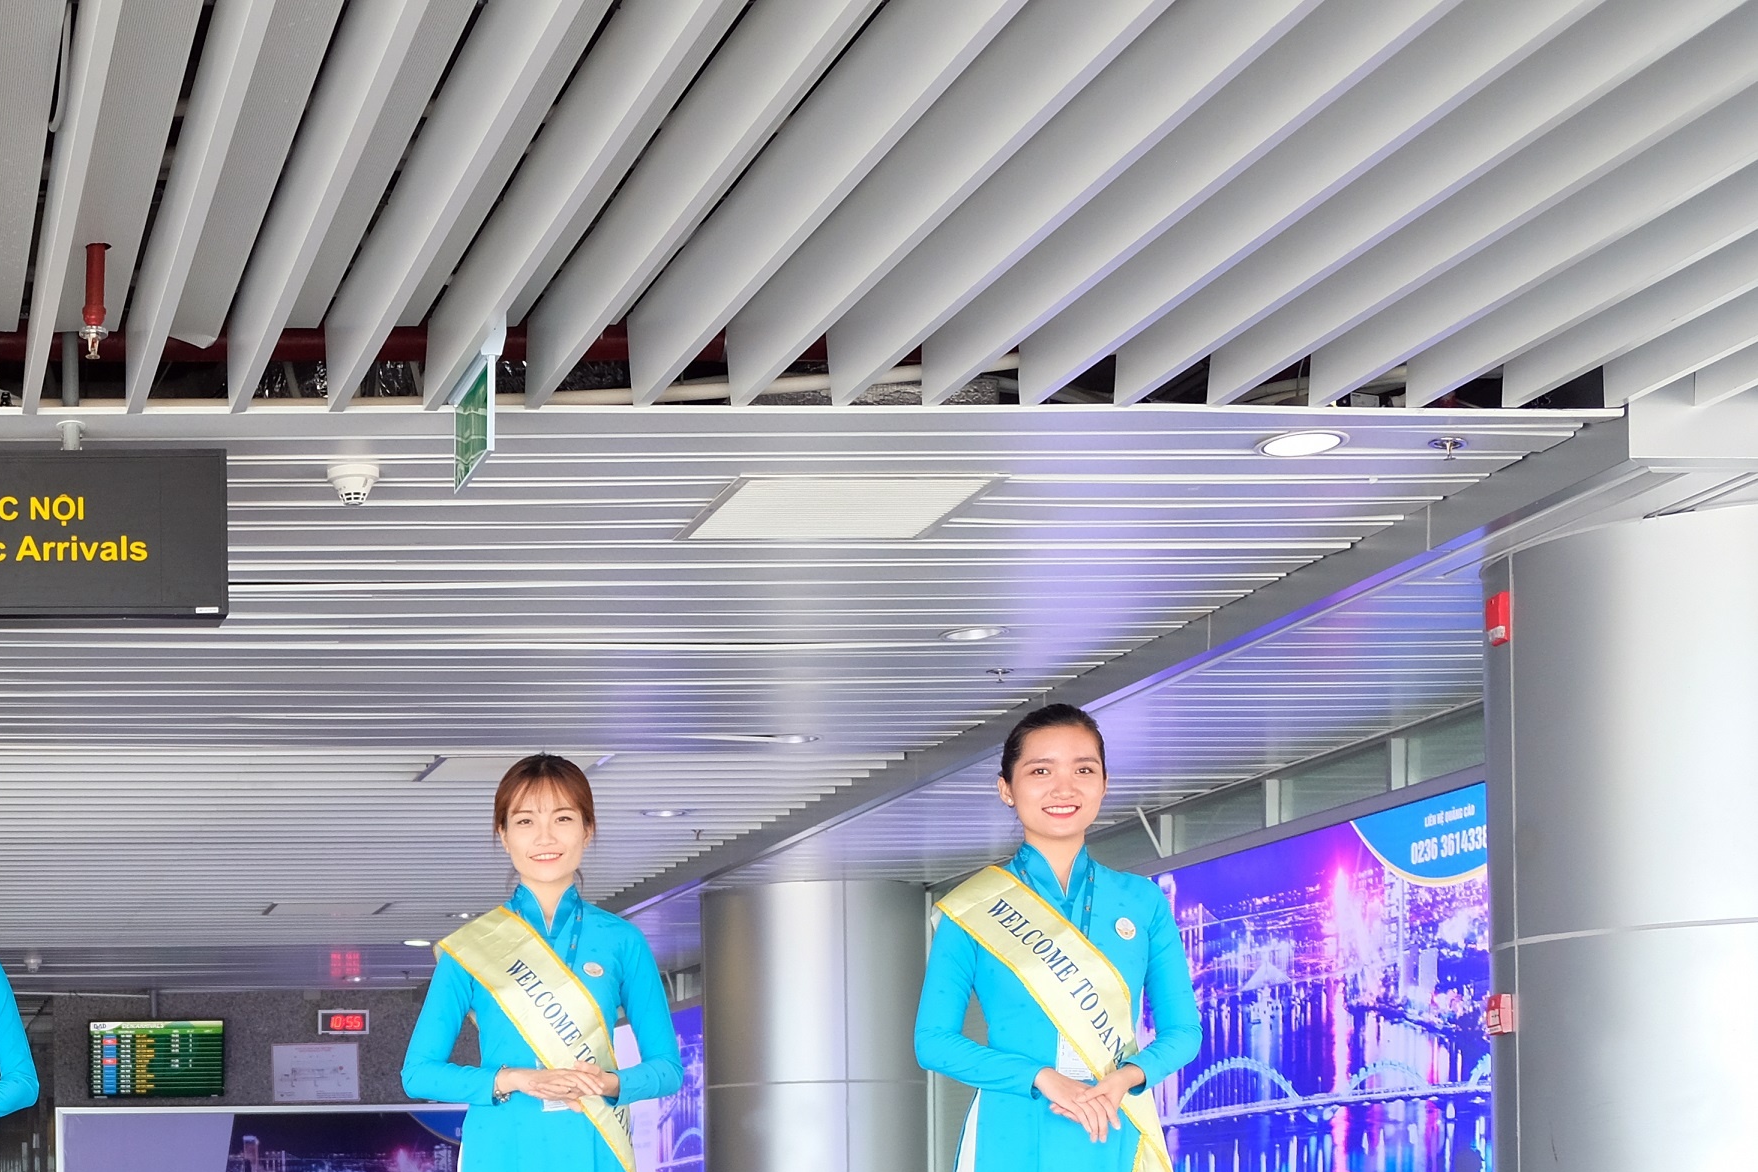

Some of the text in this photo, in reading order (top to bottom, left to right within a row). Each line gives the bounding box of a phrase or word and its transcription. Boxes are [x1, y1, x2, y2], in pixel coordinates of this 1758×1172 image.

[29, 493, 85, 527] NỘI
[15, 535, 149, 562] Arrivals
[1410, 837, 1438, 865] 0236
[986, 899, 1080, 985] WELCOME
[1069, 978, 1100, 1012] TO
[505, 958, 584, 1048] WELCOME
[330, 1015, 362, 1029] 10:55
